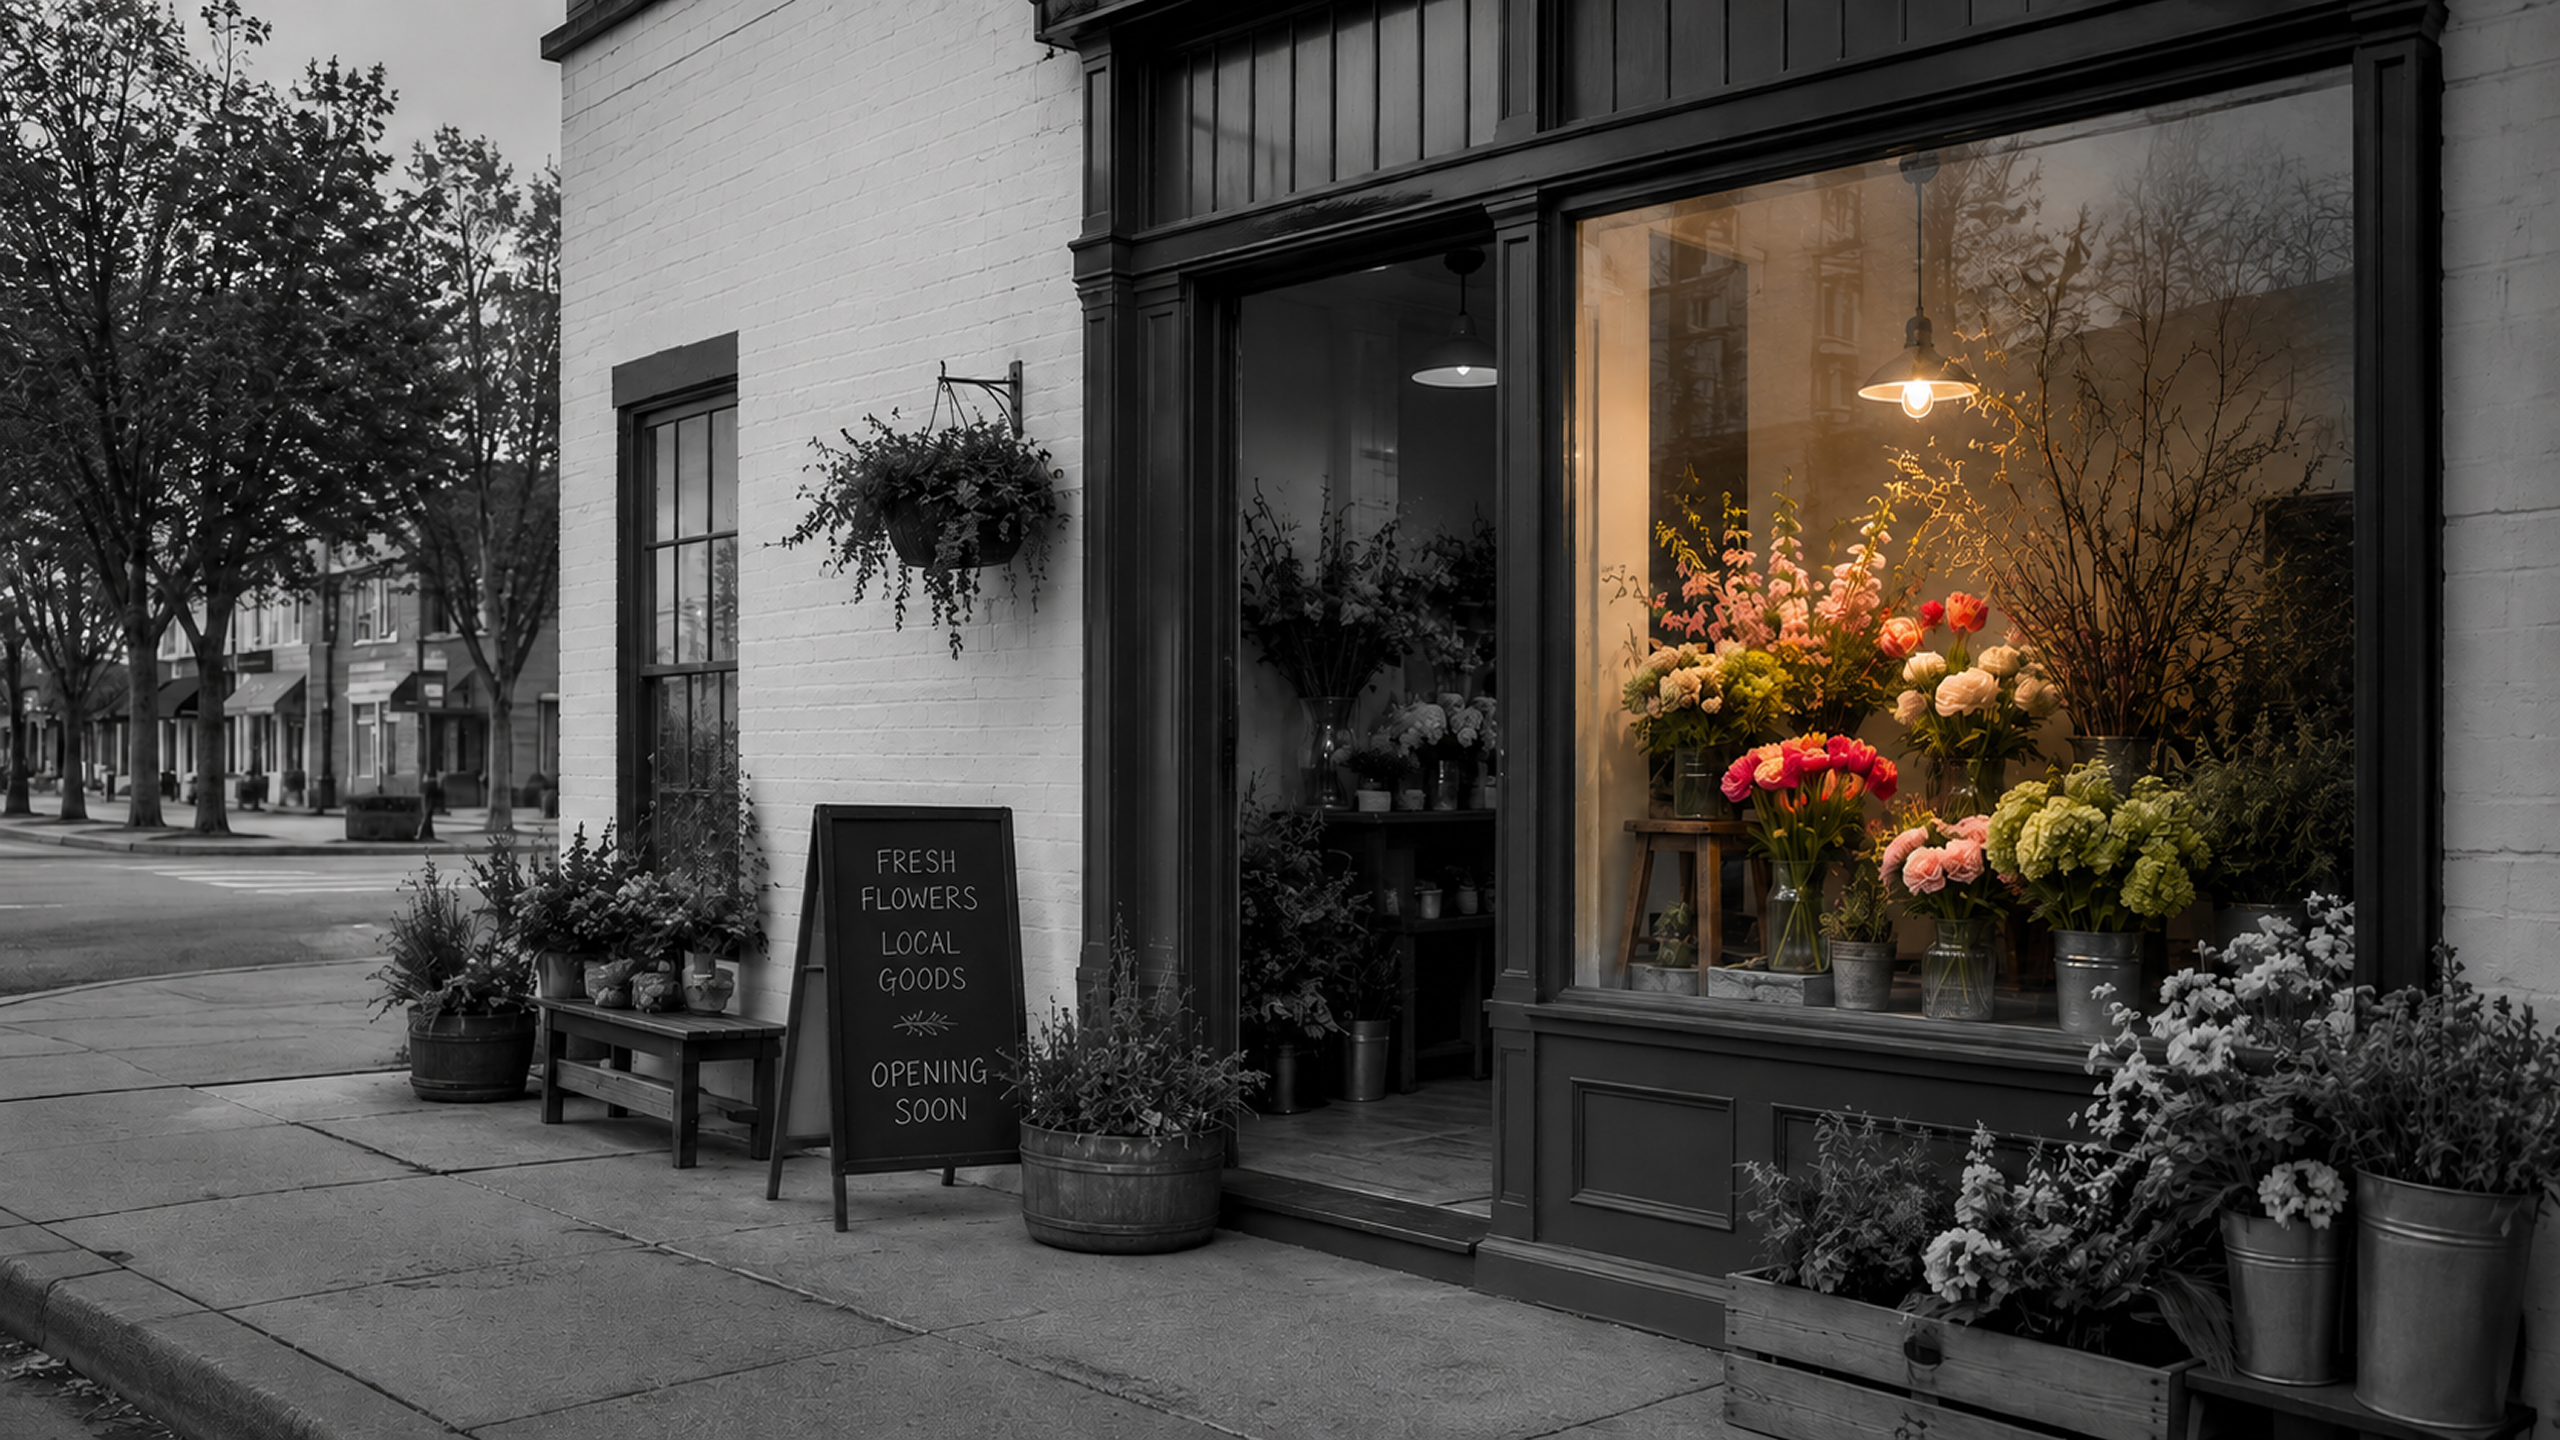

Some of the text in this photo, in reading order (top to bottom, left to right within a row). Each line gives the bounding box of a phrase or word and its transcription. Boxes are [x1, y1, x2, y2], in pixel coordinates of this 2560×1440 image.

[877, 849, 956, 875] FRESH
[861, 885, 978, 911] FLOWERS
[882, 930, 961, 956] LOCAL
[878, 966, 967, 997] GOODS
[871, 1056, 988, 1089] OPENING
[894, 1096, 967, 1125] SOON
